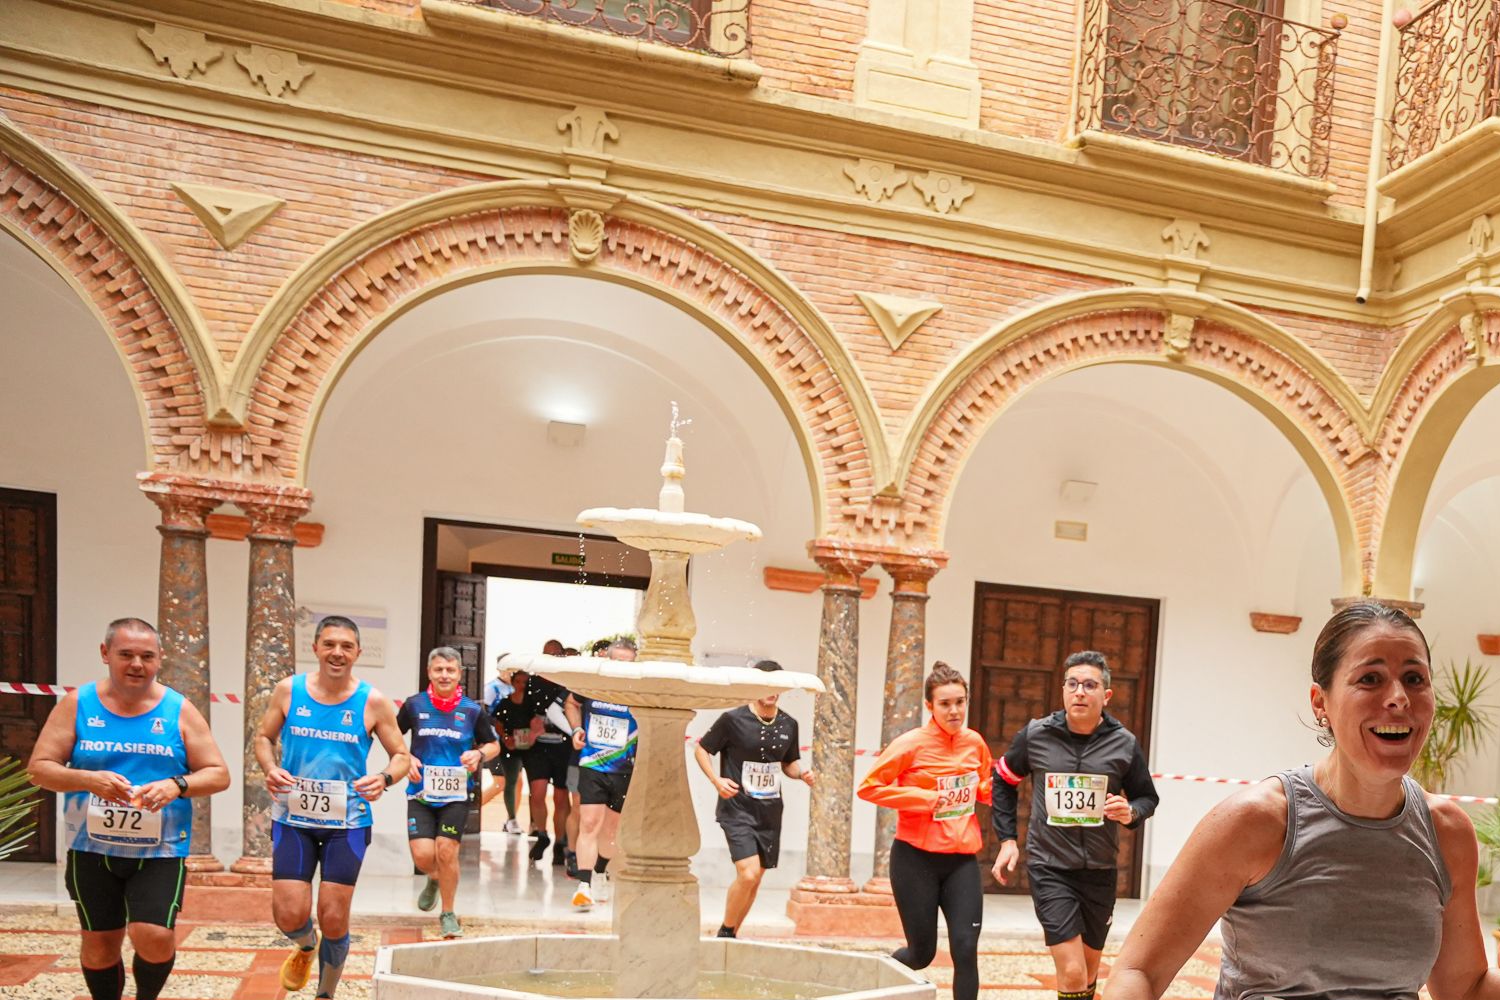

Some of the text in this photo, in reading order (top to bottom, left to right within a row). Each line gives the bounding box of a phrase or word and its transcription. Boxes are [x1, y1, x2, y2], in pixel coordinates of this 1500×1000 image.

[289, 726, 359, 744] TROTASIERRA
[418, 728, 462, 739] enerplus
[597, 726, 617, 740] 362
[80, 740, 174, 757] TROTASIERRA
[432, 778, 460, 791] 1263
[300, 794, 330, 812] 373
[1054, 791, 1096, 810] 1334
[103, 809, 142, 830] 372
